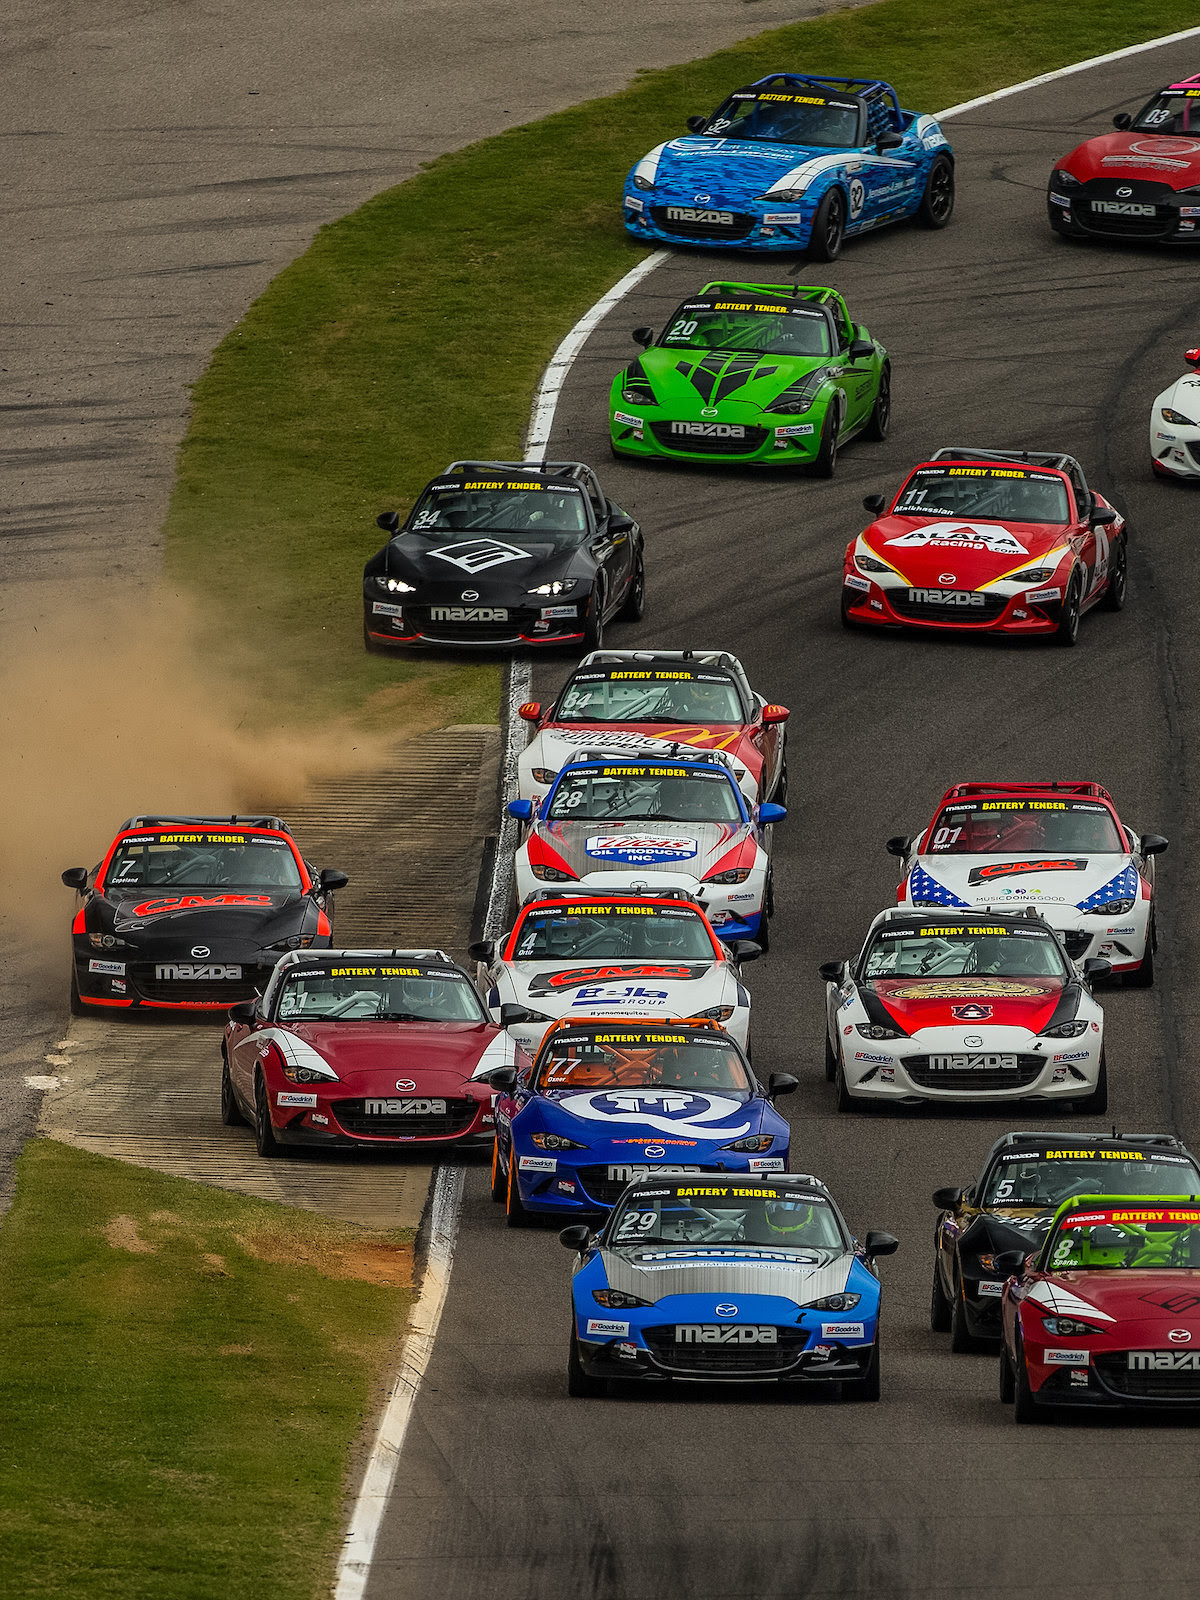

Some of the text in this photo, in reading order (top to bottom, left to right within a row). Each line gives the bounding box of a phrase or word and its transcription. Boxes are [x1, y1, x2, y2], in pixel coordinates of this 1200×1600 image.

[758, 93, 792, 103] BATTERY
[1145, 109, 1170, 123] 03
[707, 118, 731, 133] 32
[851, 186, 863, 210] 32
[667, 207, 733, 224] mazda
[1091, 201, 1155, 216] mazda
[670, 320, 698, 336] 20
[671, 422, 745, 438] mazda
[949, 468, 988, 477] BATTERY
[464, 482, 504, 490] BATTERY
[905, 489, 928, 504] 11
[416, 510, 441, 525] 34
[903, 533, 1018, 547] ALARA
[930, 540, 984, 550] Racing
[909, 588, 985, 606] mazda
[431, 607, 508, 621] mazda
[563, 692, 593, 709] 84
[603, 768, 646, 776] BATTERY
[554, 791, 583, 808] 28
[982, 802, 1024, 810] BATTERY
[160, 835, 203, 843] BATTERY
[934, 827, 962, 843] 01
[603, 838, 691, 849] LUCAS
[618, 849, 691, 857] PRODUCTS
[121, 861, 137, 877] 7
[979, 859, 1077, 878] CMC
[133, 895, 272, 916] CMC
[567, 906, 611, 914] BATTERY
[920, 928, 964, 936] BATTERY
[521, 933, 537, 949] 4
[868, 952, 897, 969] 54
[156, 964, 242, 980] mazda
[331, 968, 377, 976] BATTERY
[549, 966, 691, 986] CMC
[281, 992, 308, 1010] 51
[595, 1035, 642, 1043] BATTERY
[856, 1052, 893, 1063] BFGoodrich
[930, 1054, 1017, 1069] mazda
[1054, 1051, 1089, 1061] BFGoodrich
[549, 1058, 583, 1075] 77
[281, 1095, 313, 1103] BFGoodrich
[365, 1099, 446, 1115] mazda
[1003, 1153, 1039, 1161] mazda
[1046, 1150, 1096, 1160] BATTERY
[523, 1159, 553, 1168] BFGoodrich
[677, 1188, 728, 1197] BATTERY
[997, 1180, 1015, 1197] 5
[619, 1213, 657, 1231] 29
[1067, 1214, 1105, 1222] mazda
[1112, 1211, 1163, 1221] BATTERY
[1054, 1240, 1074, 1258] 8
[642, 1251, 814, 1263] HOWARD
[591, 1323, 625, 1331] BFGoodrich
[676, 1325, 777, 1343] mazda
[1047, 1352, 1084, 1360] BFGoodrich
